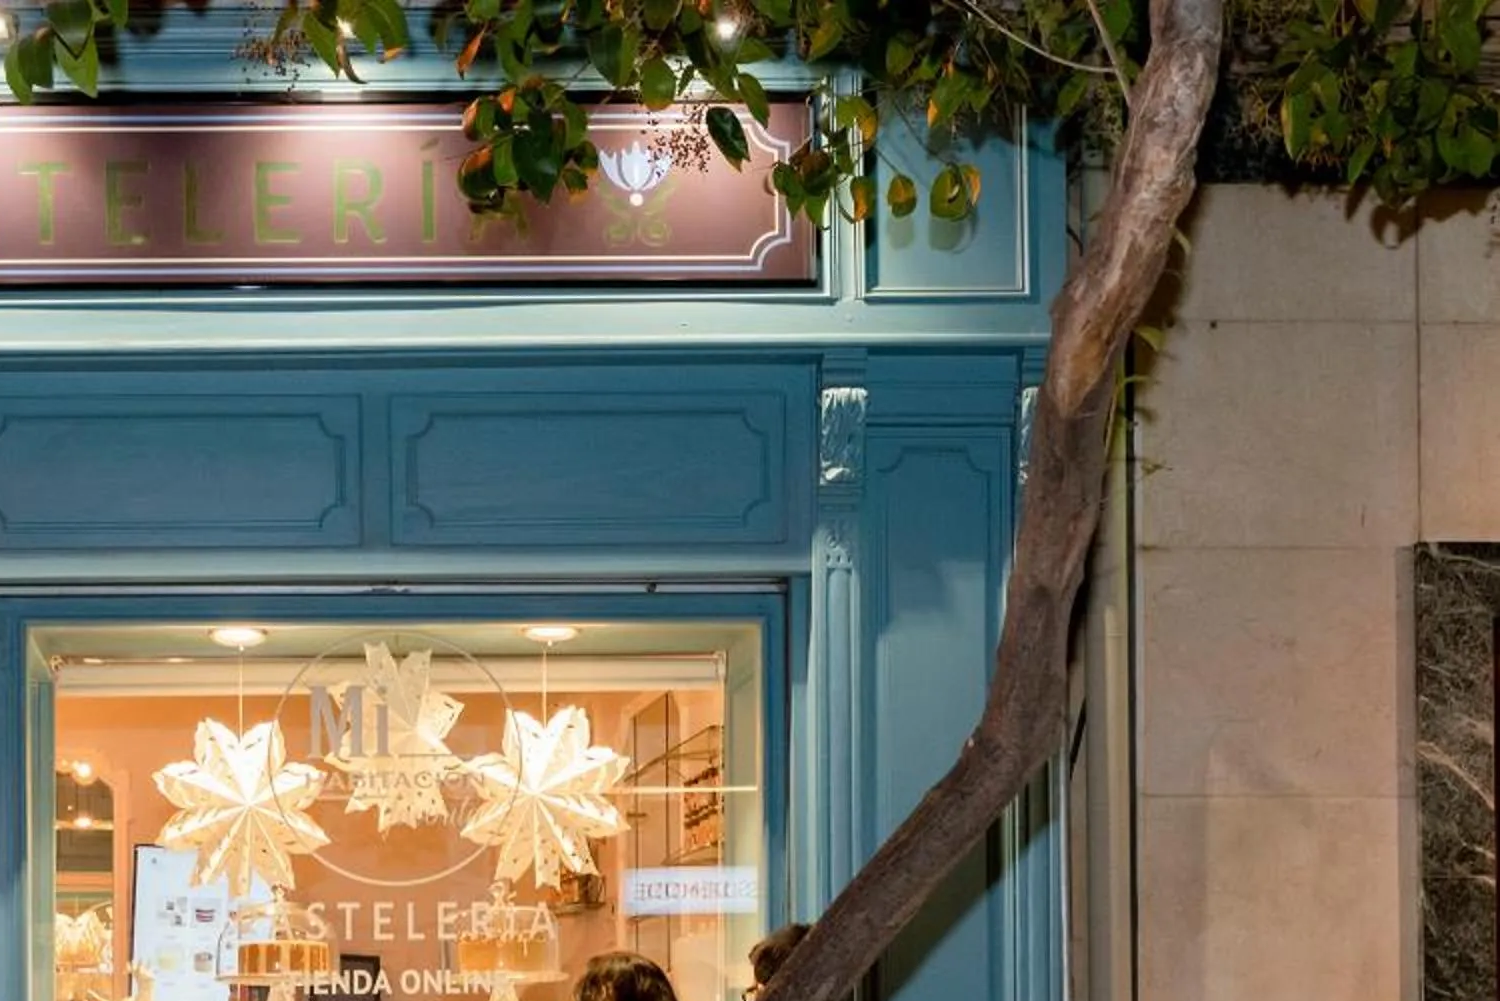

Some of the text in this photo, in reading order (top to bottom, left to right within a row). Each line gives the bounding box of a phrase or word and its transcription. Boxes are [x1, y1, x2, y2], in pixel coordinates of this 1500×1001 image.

[306, 684, 392, 758] Mi
[286, 969, 507, 995] IENDA ONLIN
